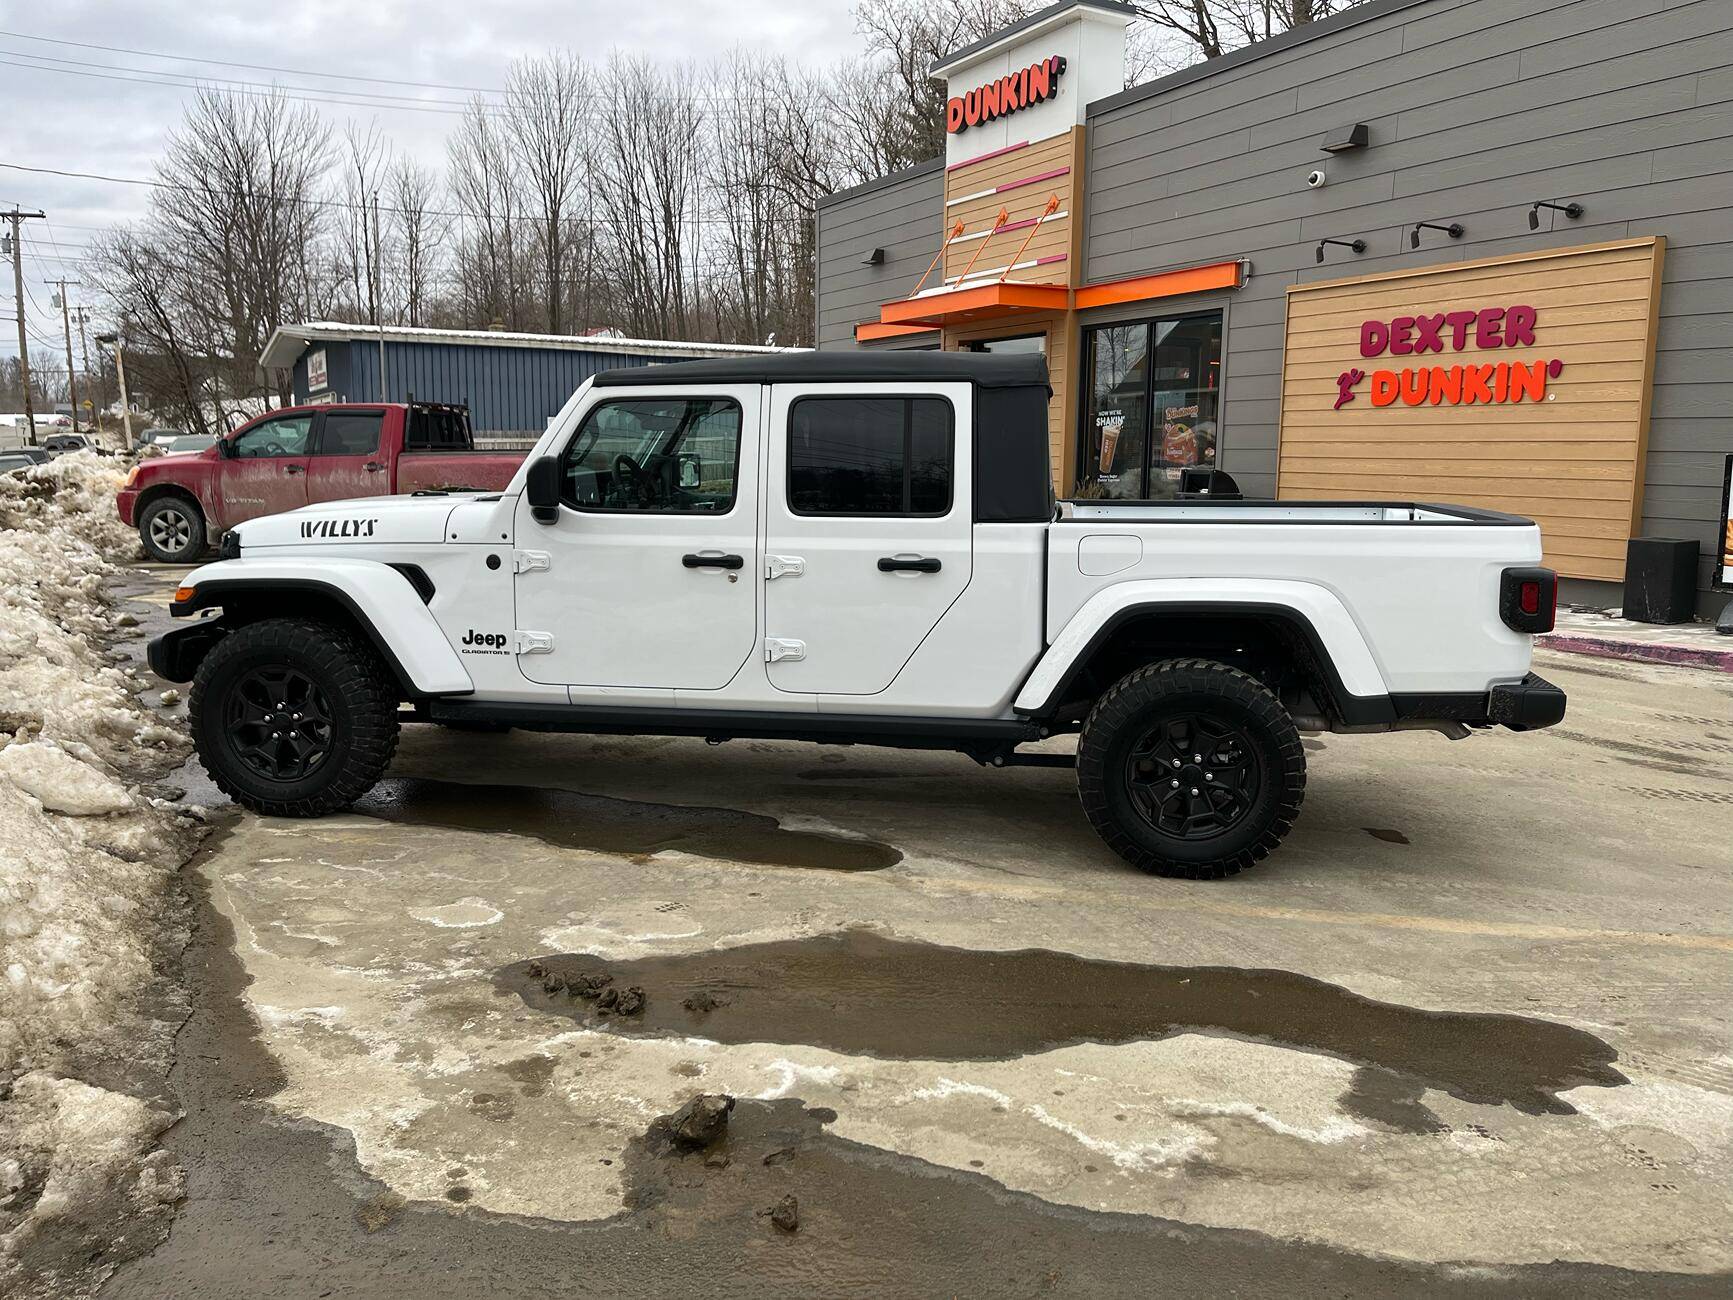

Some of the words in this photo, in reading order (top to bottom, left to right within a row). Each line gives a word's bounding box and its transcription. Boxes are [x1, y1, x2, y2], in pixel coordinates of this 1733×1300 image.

[947, 55, 1063, 134] DUNKIN'
[1360, 305, 1537, 357] DEXTER
[1371, 359, 1563, 407] DUNKIN'
[20, 427, 26, 435] 7
[301, 519, 378, 538] WILLYS
[462, 629, 506, 649] Jeep
